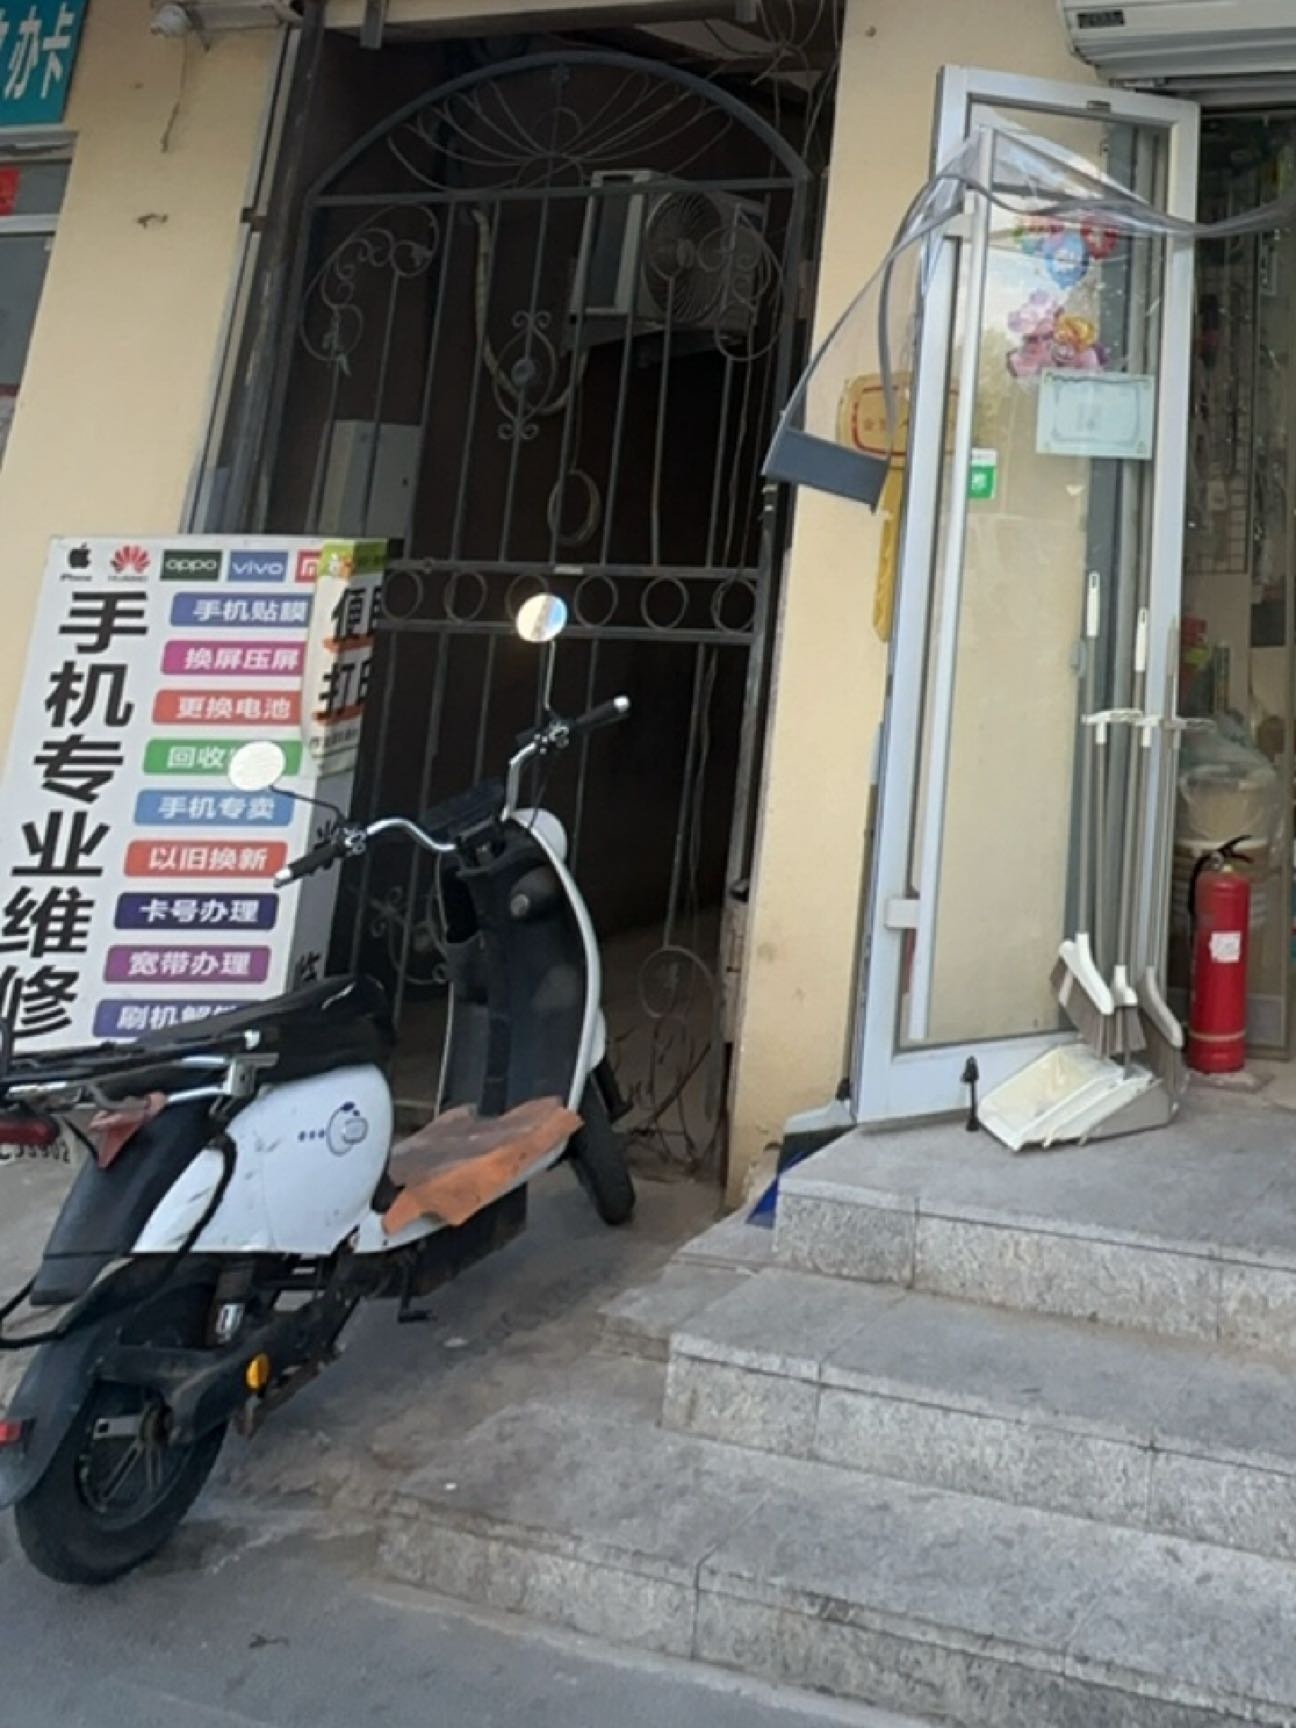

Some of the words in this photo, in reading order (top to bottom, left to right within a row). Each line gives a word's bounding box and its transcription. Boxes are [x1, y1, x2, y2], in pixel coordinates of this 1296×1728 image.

[0, 2, 75, 100] 办卡
[192, 599, 309, 623] 手机贴膜
[185, 648, 299, 671] 换屏压屏
[175, 696, 291, 720] 更换电池
[0, 591, 149, 1042] 手机专业维修
[158, 797, 276, 820] 手机专卖
[148, 845, 270, 872] 以旧换新
[138, 897, 260, 923] 卡号办理
[128, 950, 251, 977] 宽带办理
